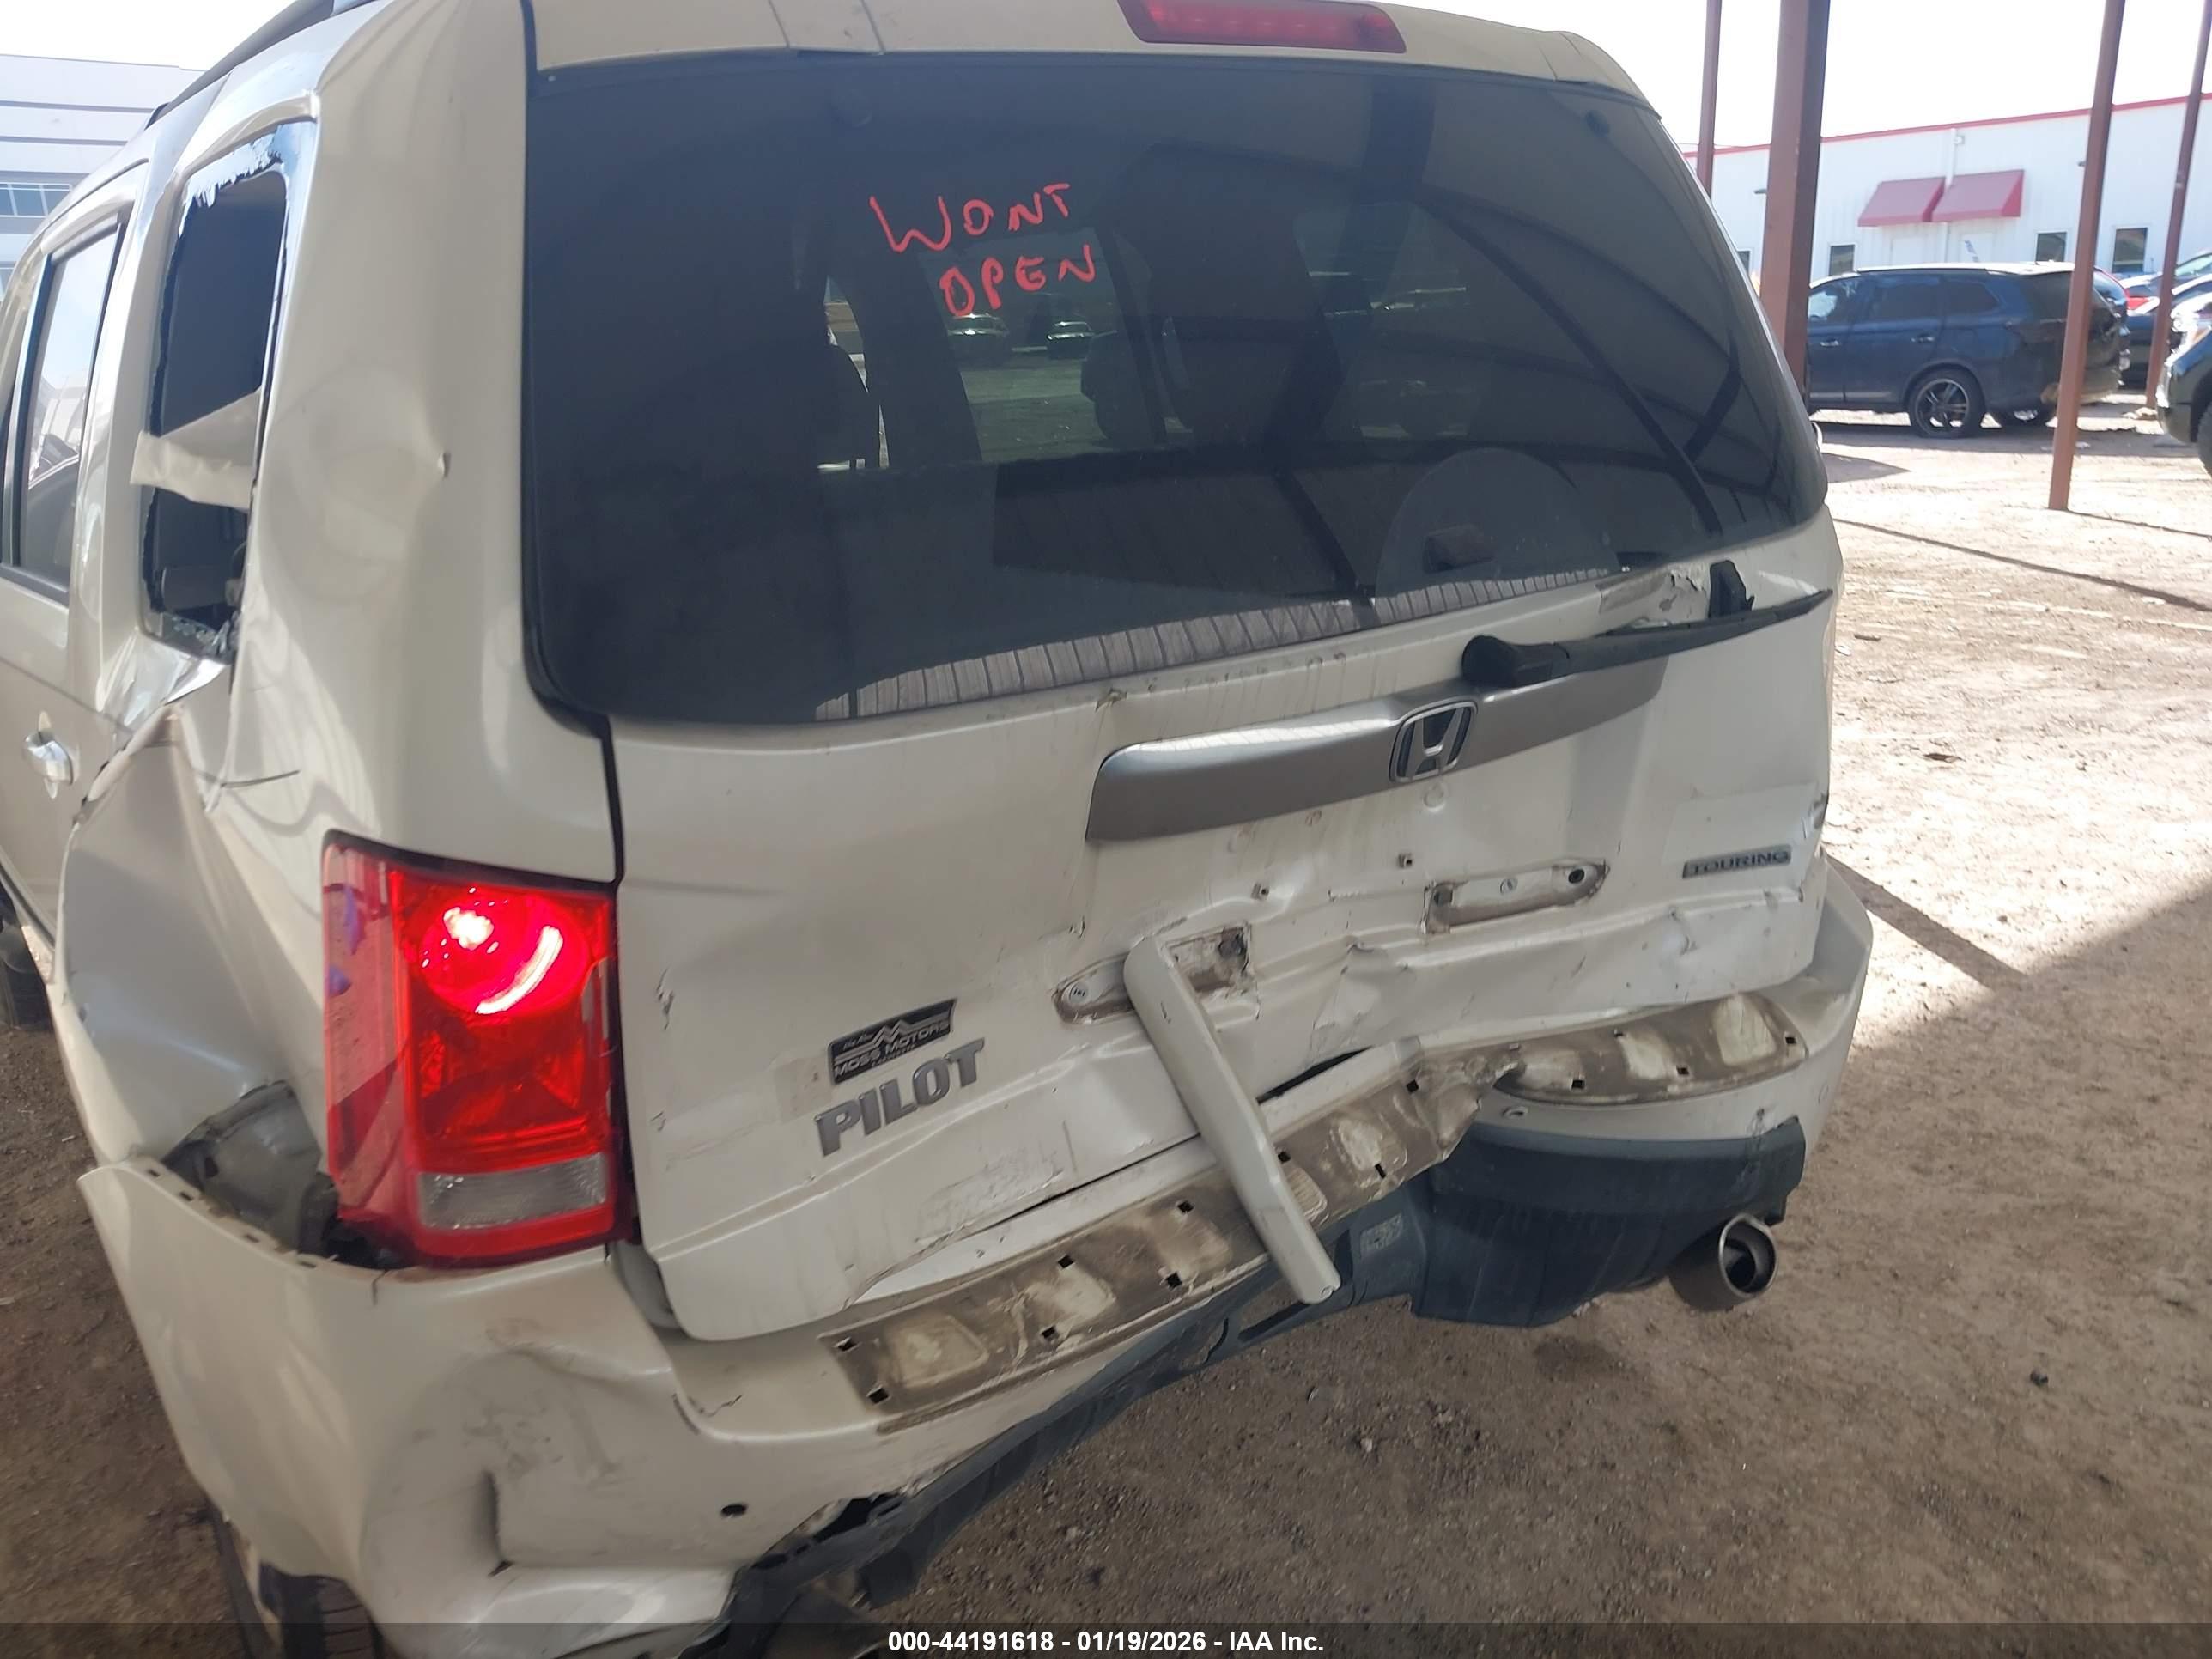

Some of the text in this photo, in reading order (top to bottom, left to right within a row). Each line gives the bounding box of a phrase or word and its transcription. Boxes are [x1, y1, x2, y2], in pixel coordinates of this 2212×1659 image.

[869, 183, 1071, 252] WONT
[939, 244, 1096, 316] OPEN
[1692, 850, 1790, 875] TOURING
[884, 1018, 950, 1056] MOTORS
[814, 1037, 985, 1157] PILOT
